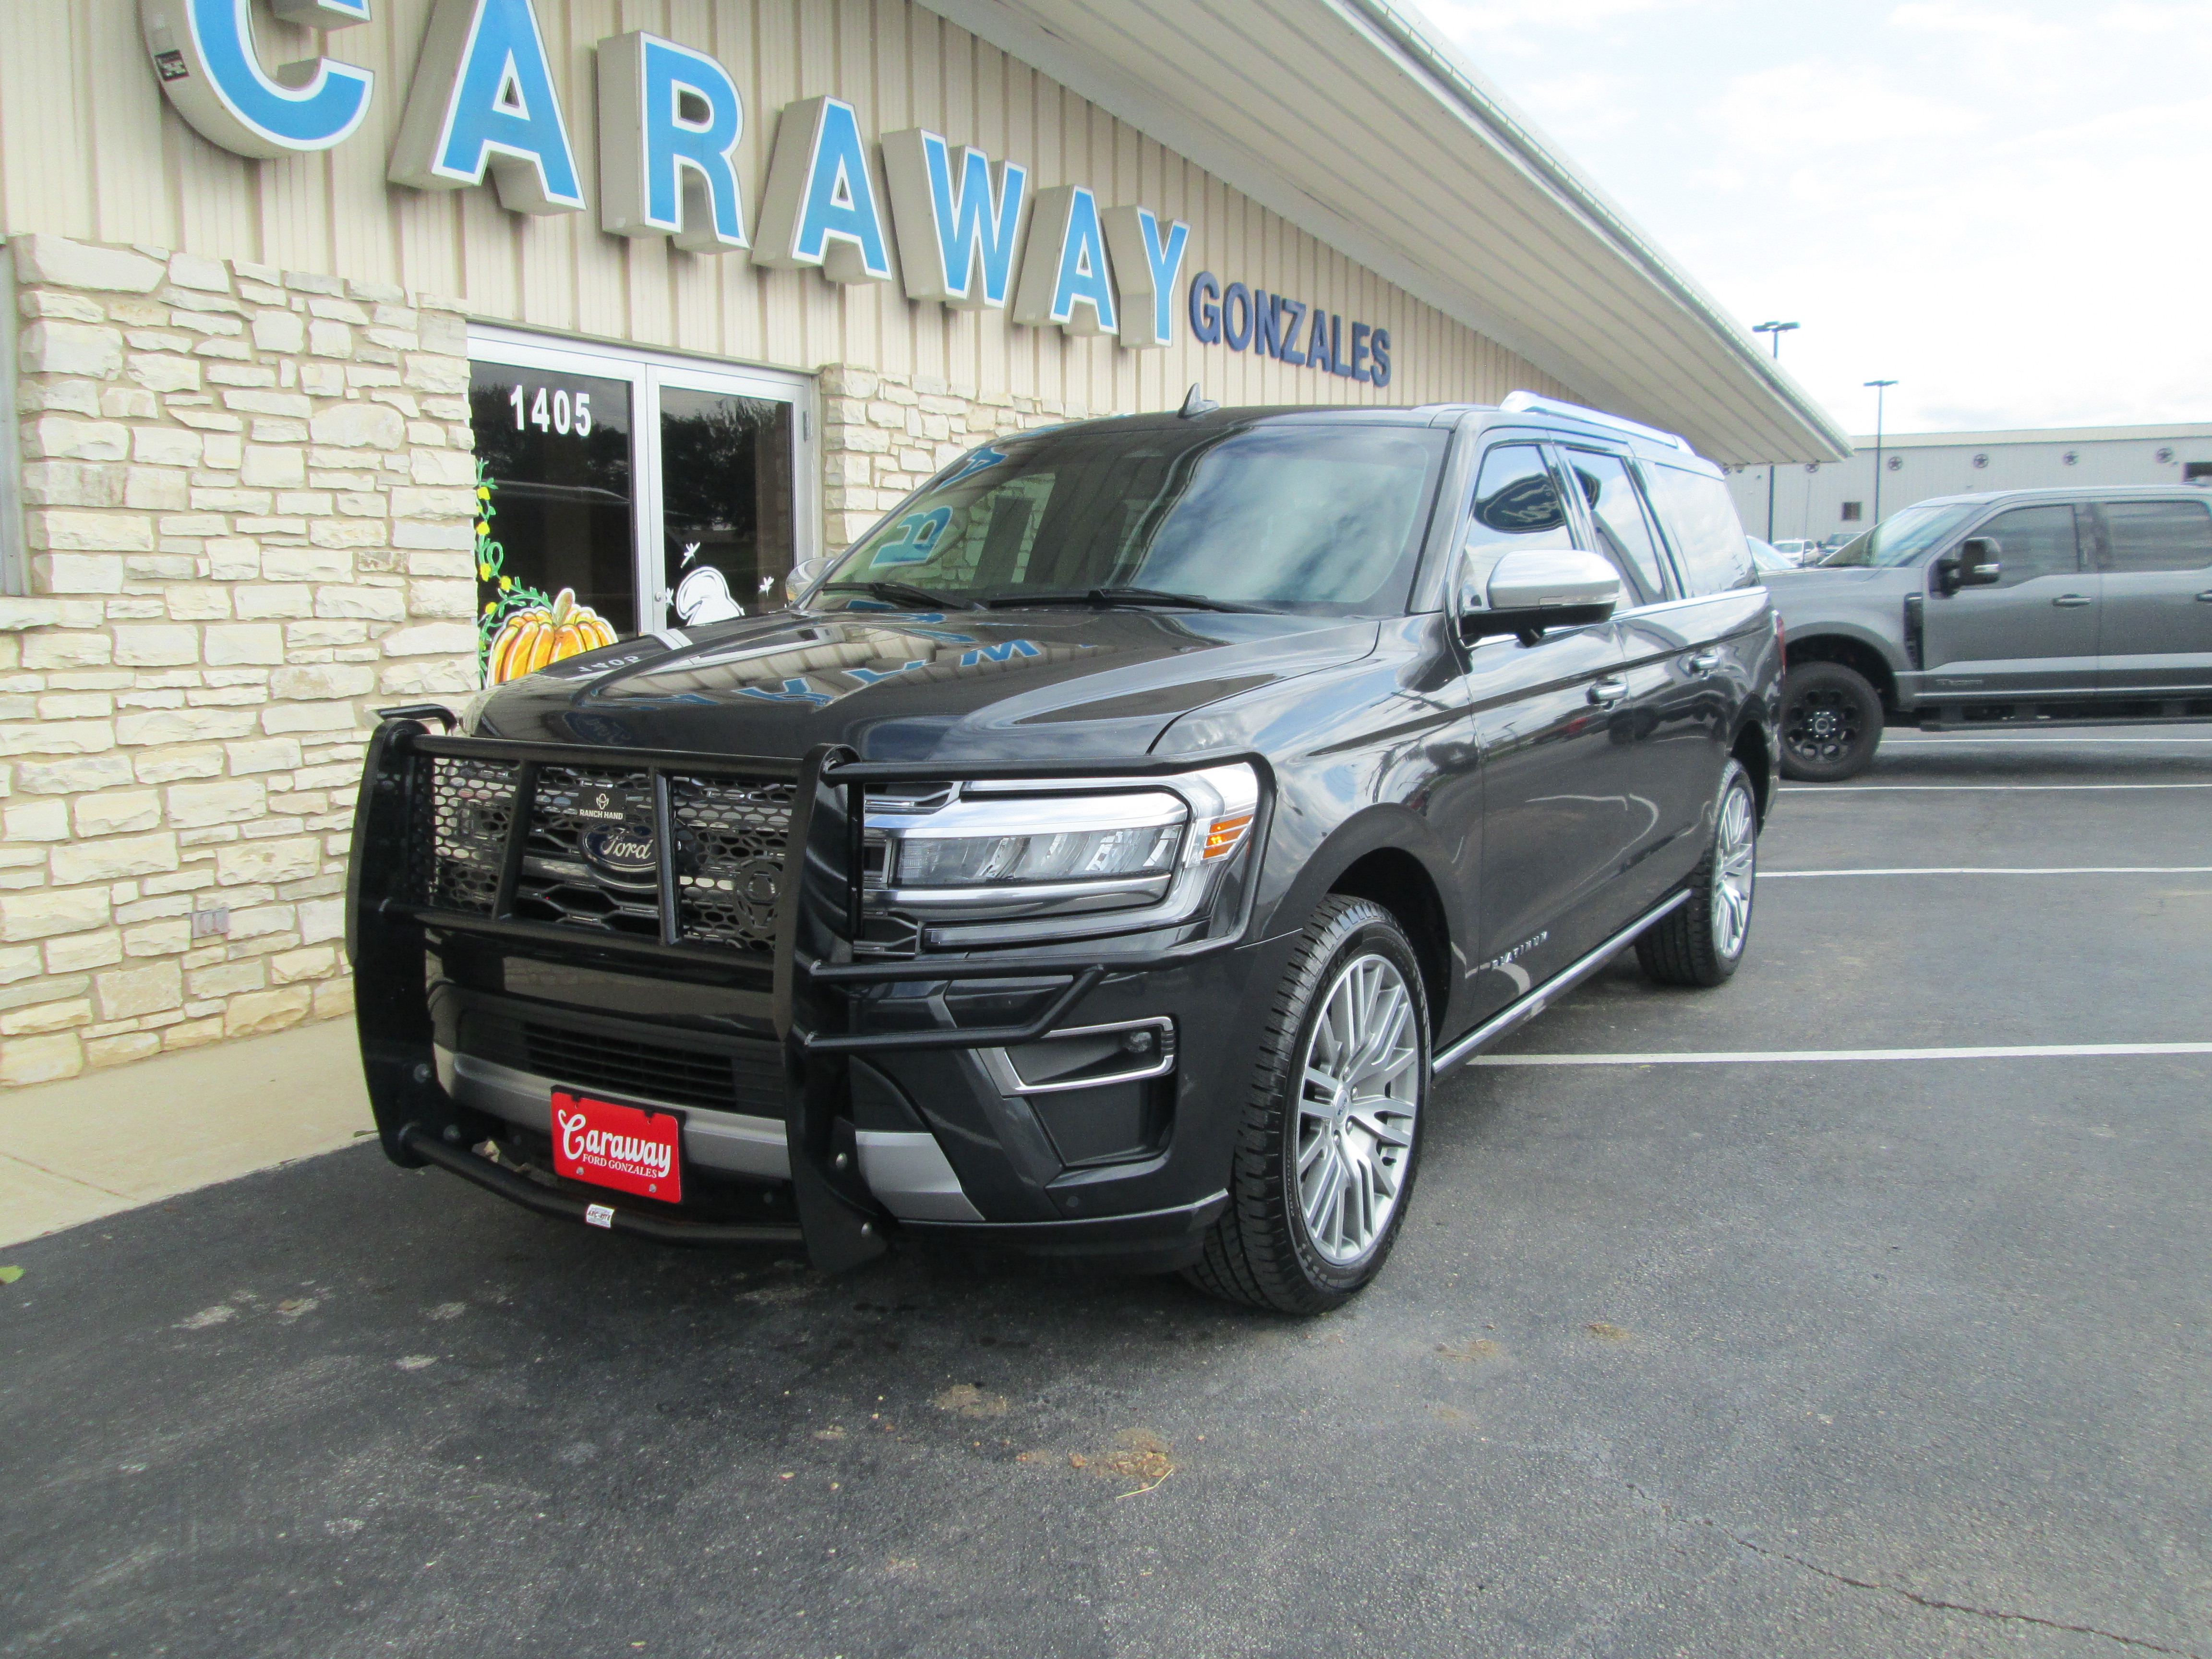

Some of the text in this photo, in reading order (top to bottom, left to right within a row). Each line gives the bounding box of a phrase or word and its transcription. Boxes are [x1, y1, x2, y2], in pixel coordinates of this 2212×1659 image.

[185, 0, 1192, 349] CARAWAY
[1189, 270, 1392, 388] GONZALES
[509, 384, 592, 437] 1405
[579, 809, 624, 820] RANCH HAND
[601, 833, 654, 859] Ford
[558, 1109, 671, 1178] Caraway
[582, 1154, 658, 1178] FORD GONZALES
